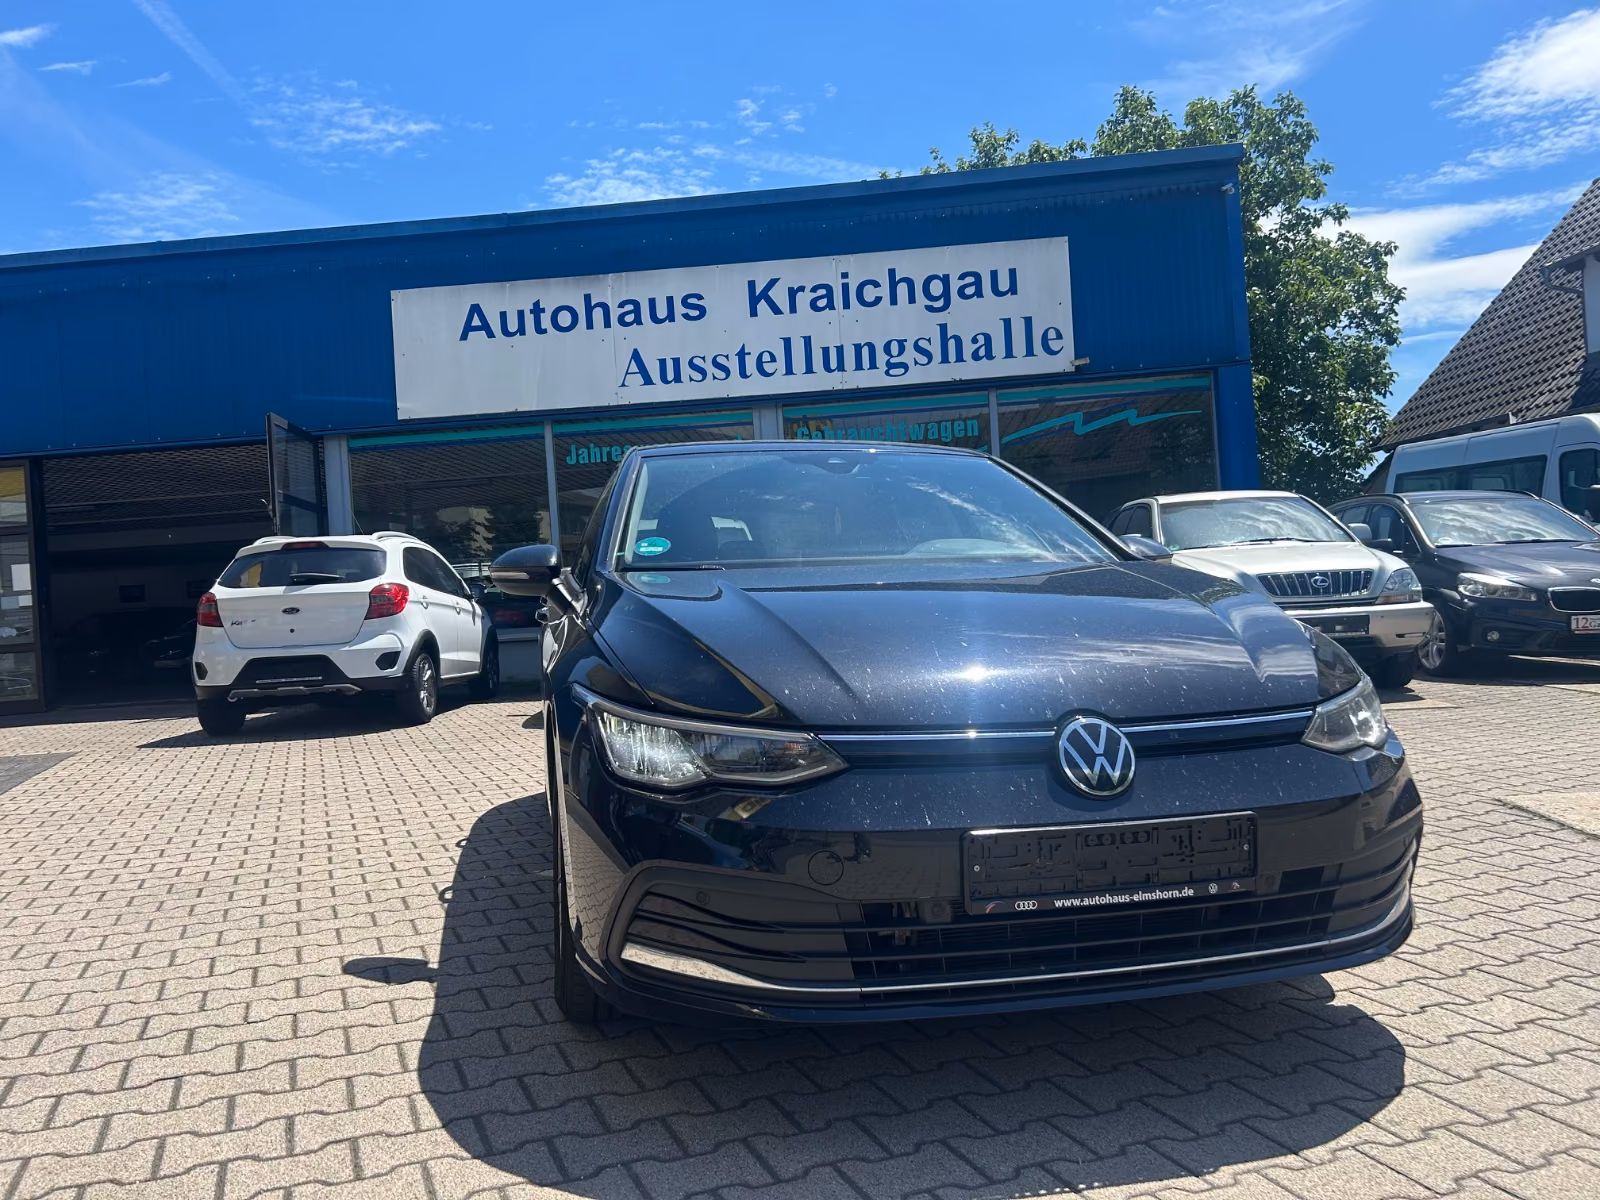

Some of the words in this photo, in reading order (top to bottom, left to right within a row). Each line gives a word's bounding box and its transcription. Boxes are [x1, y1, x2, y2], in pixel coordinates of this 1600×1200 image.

[457, 291, 708, 342] Autohaus
[747, 266, 1019, 319] Kraichgau
[617, 315, 1065, 388] Ausstellungshalle
[1053, 886, 1195, 908] www.autohaus-elmshorn.de
